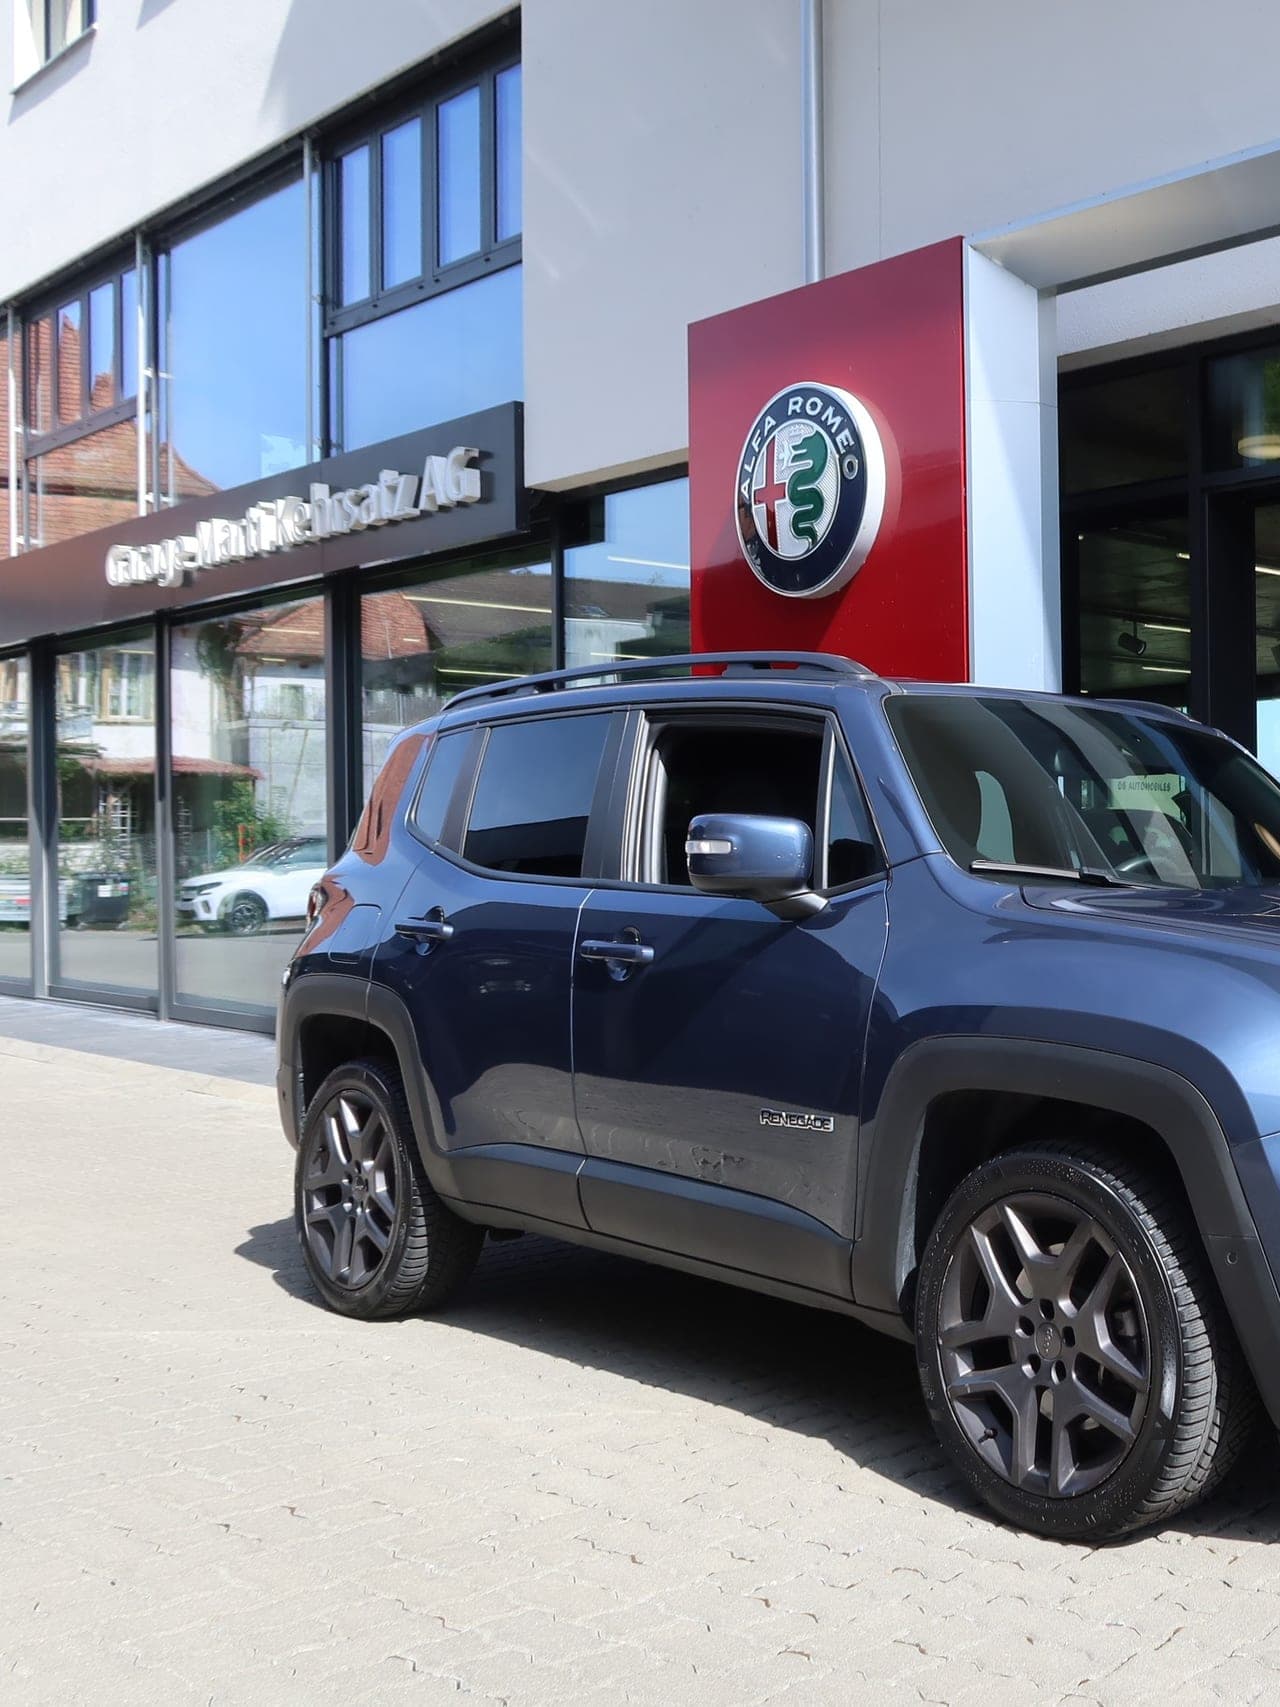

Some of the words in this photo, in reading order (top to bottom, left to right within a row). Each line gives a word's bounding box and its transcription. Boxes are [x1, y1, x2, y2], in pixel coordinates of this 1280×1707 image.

[420, 447, 481, 512] AG
[740, 415, 777, 500] ALFA
[787, 396, 859, 480] ROMEO
[760, 1107, 834, 1132] RENEGADE
